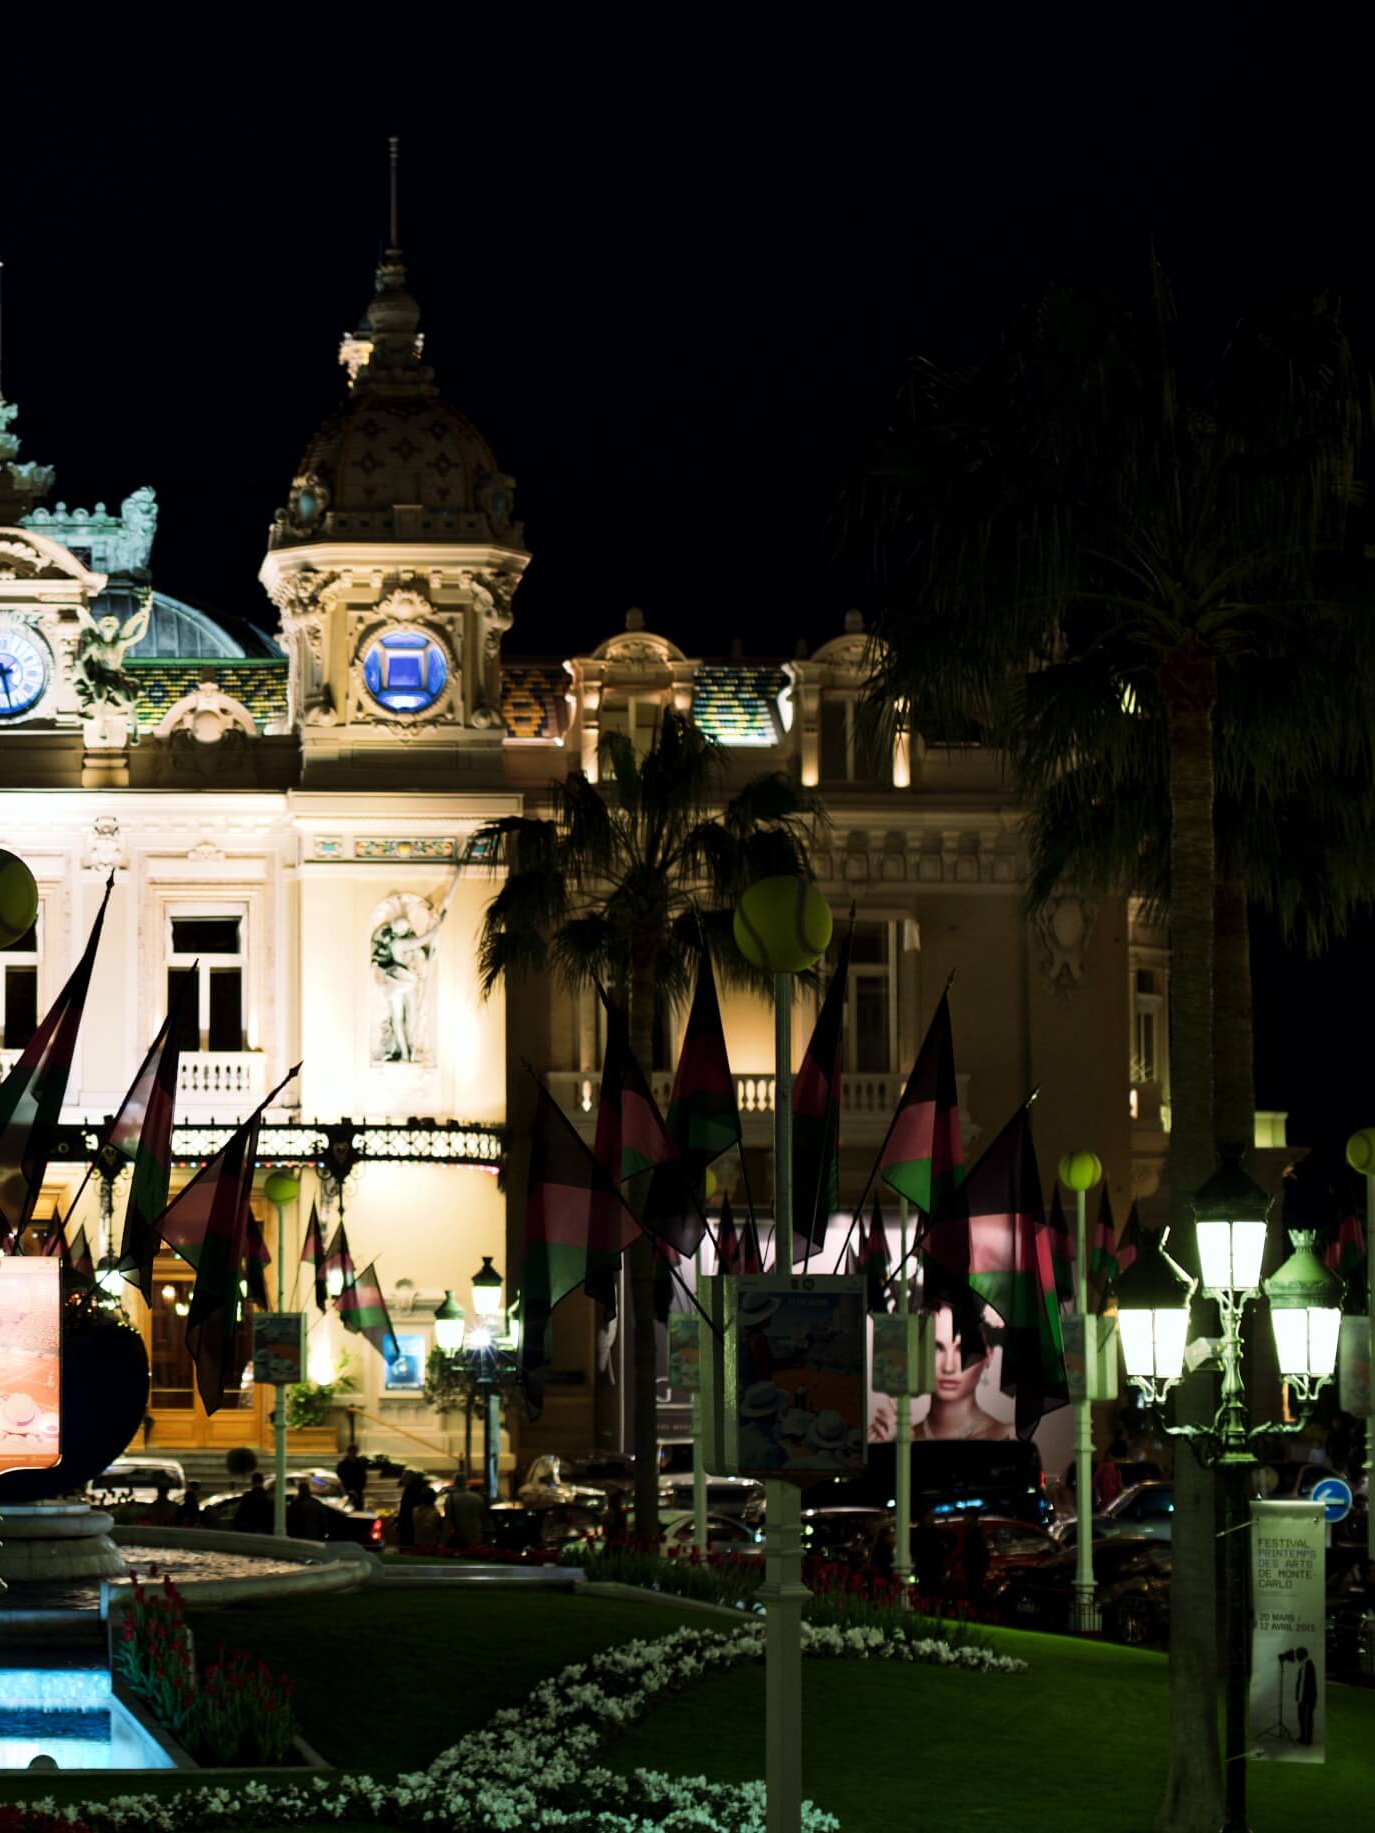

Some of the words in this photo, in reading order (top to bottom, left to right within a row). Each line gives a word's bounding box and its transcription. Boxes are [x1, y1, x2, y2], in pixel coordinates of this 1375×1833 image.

[1258, 1538, 1310, 1548] FESTIVAL
[1258, 1549, 1316, 1559] PRINTEMPS
[1258, 1559, 1278, 1569] DES
[1285, 1559, 1313, 1569] ARTS
[1258, 1569, 1273, 1578] DE
[1278, 1569, 1318, 1579] MONTE-
[1258, 1579, 1293, 1589] CARLO
[1259, 1612, 1270, 1621] 20
[1272, 1613, 1294, 1622] MARS
[1260, 1622, 1269, 1631] 12
[1271, 1622, 1294, 1631] AVRIL
[1296, 1623, 1316, 1632] 2015
